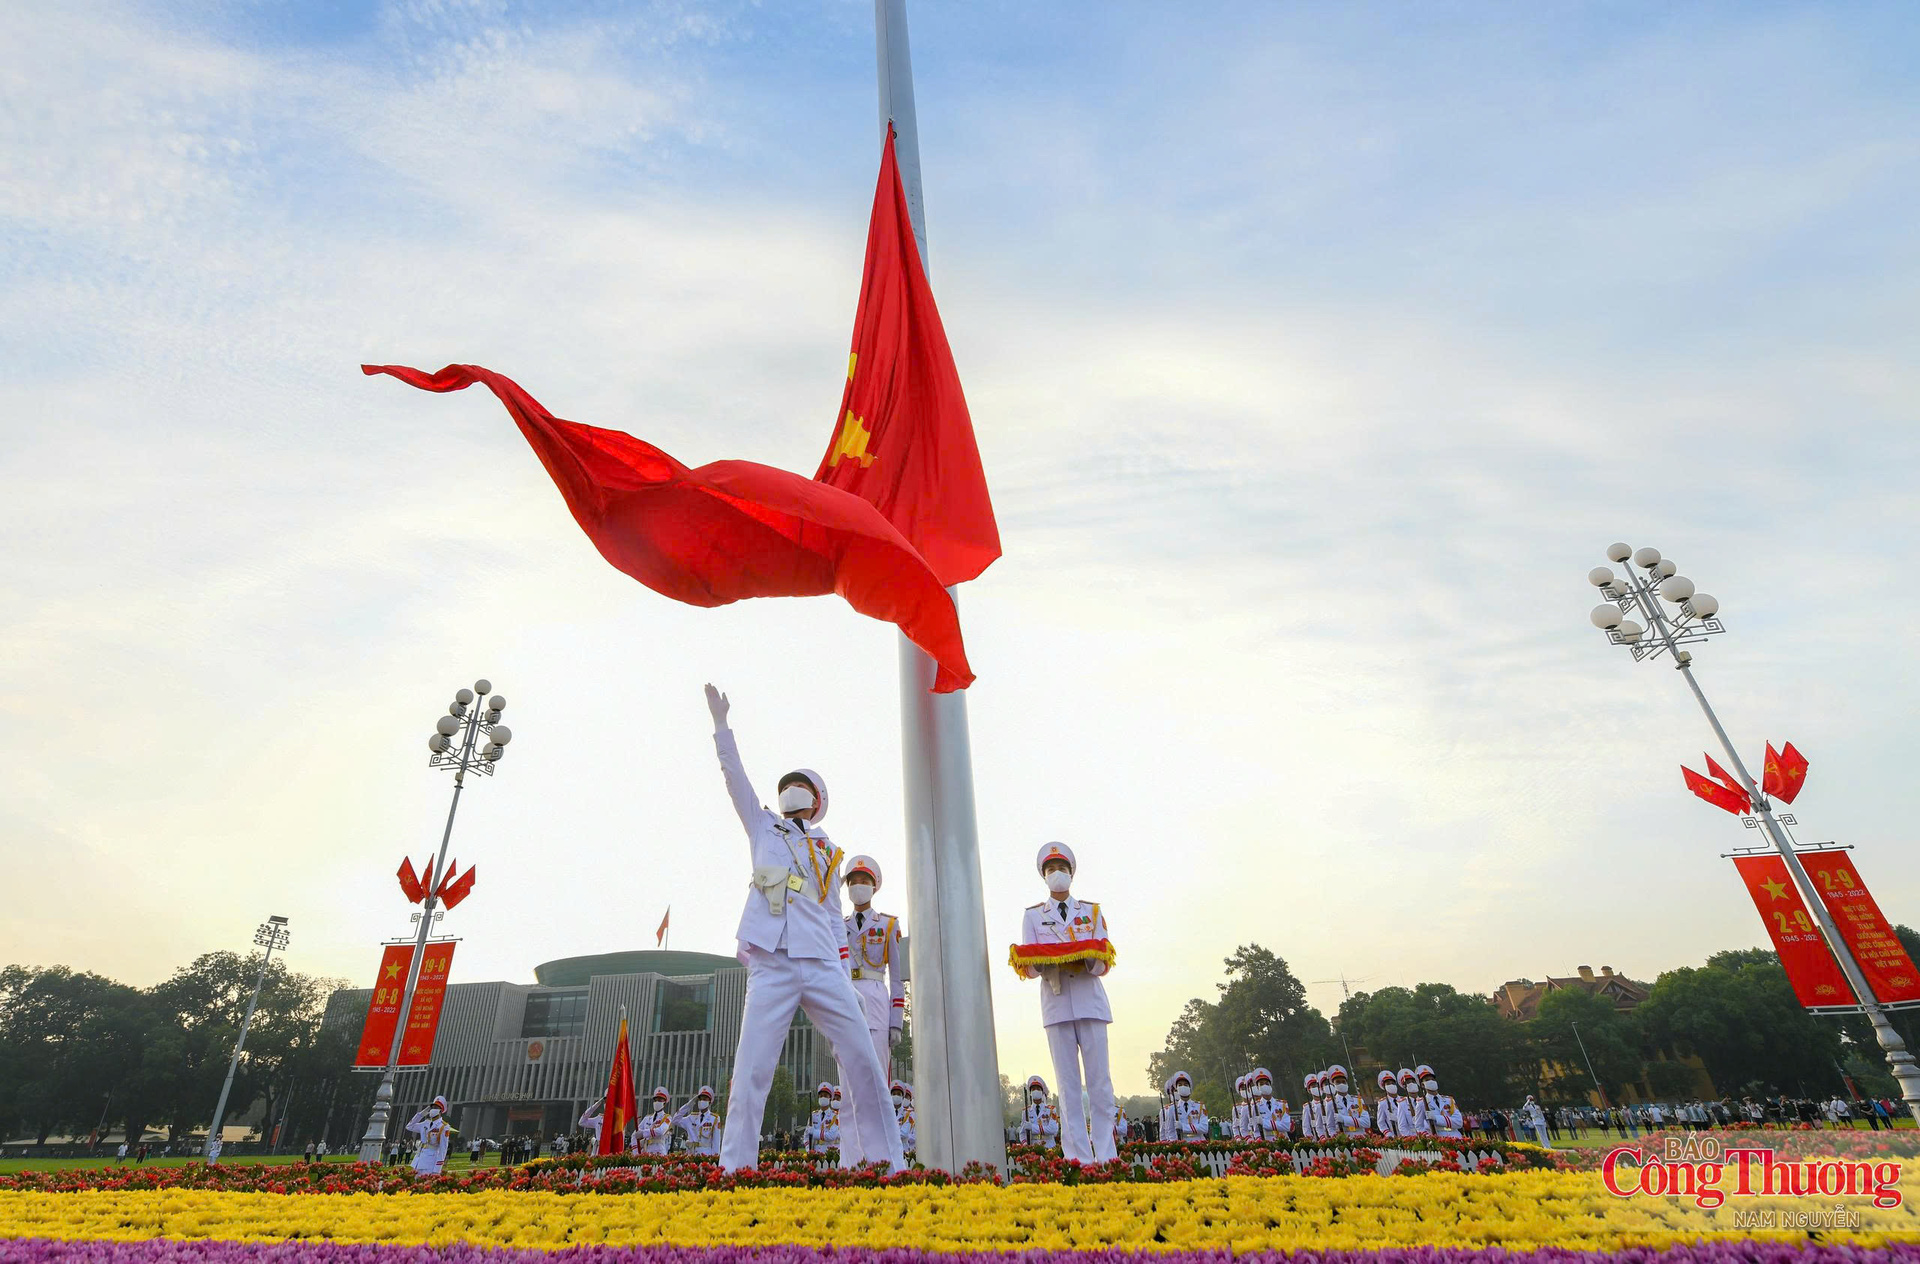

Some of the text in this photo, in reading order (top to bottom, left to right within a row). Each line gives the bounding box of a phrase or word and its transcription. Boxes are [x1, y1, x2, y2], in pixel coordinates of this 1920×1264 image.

[1817, 868, 1855, 890] 2-9
[1773, 909, 1812, 933] 2-9
[1780, 934, 1800, 943] 1945
[375, 987, 399, 1005] 19-8
